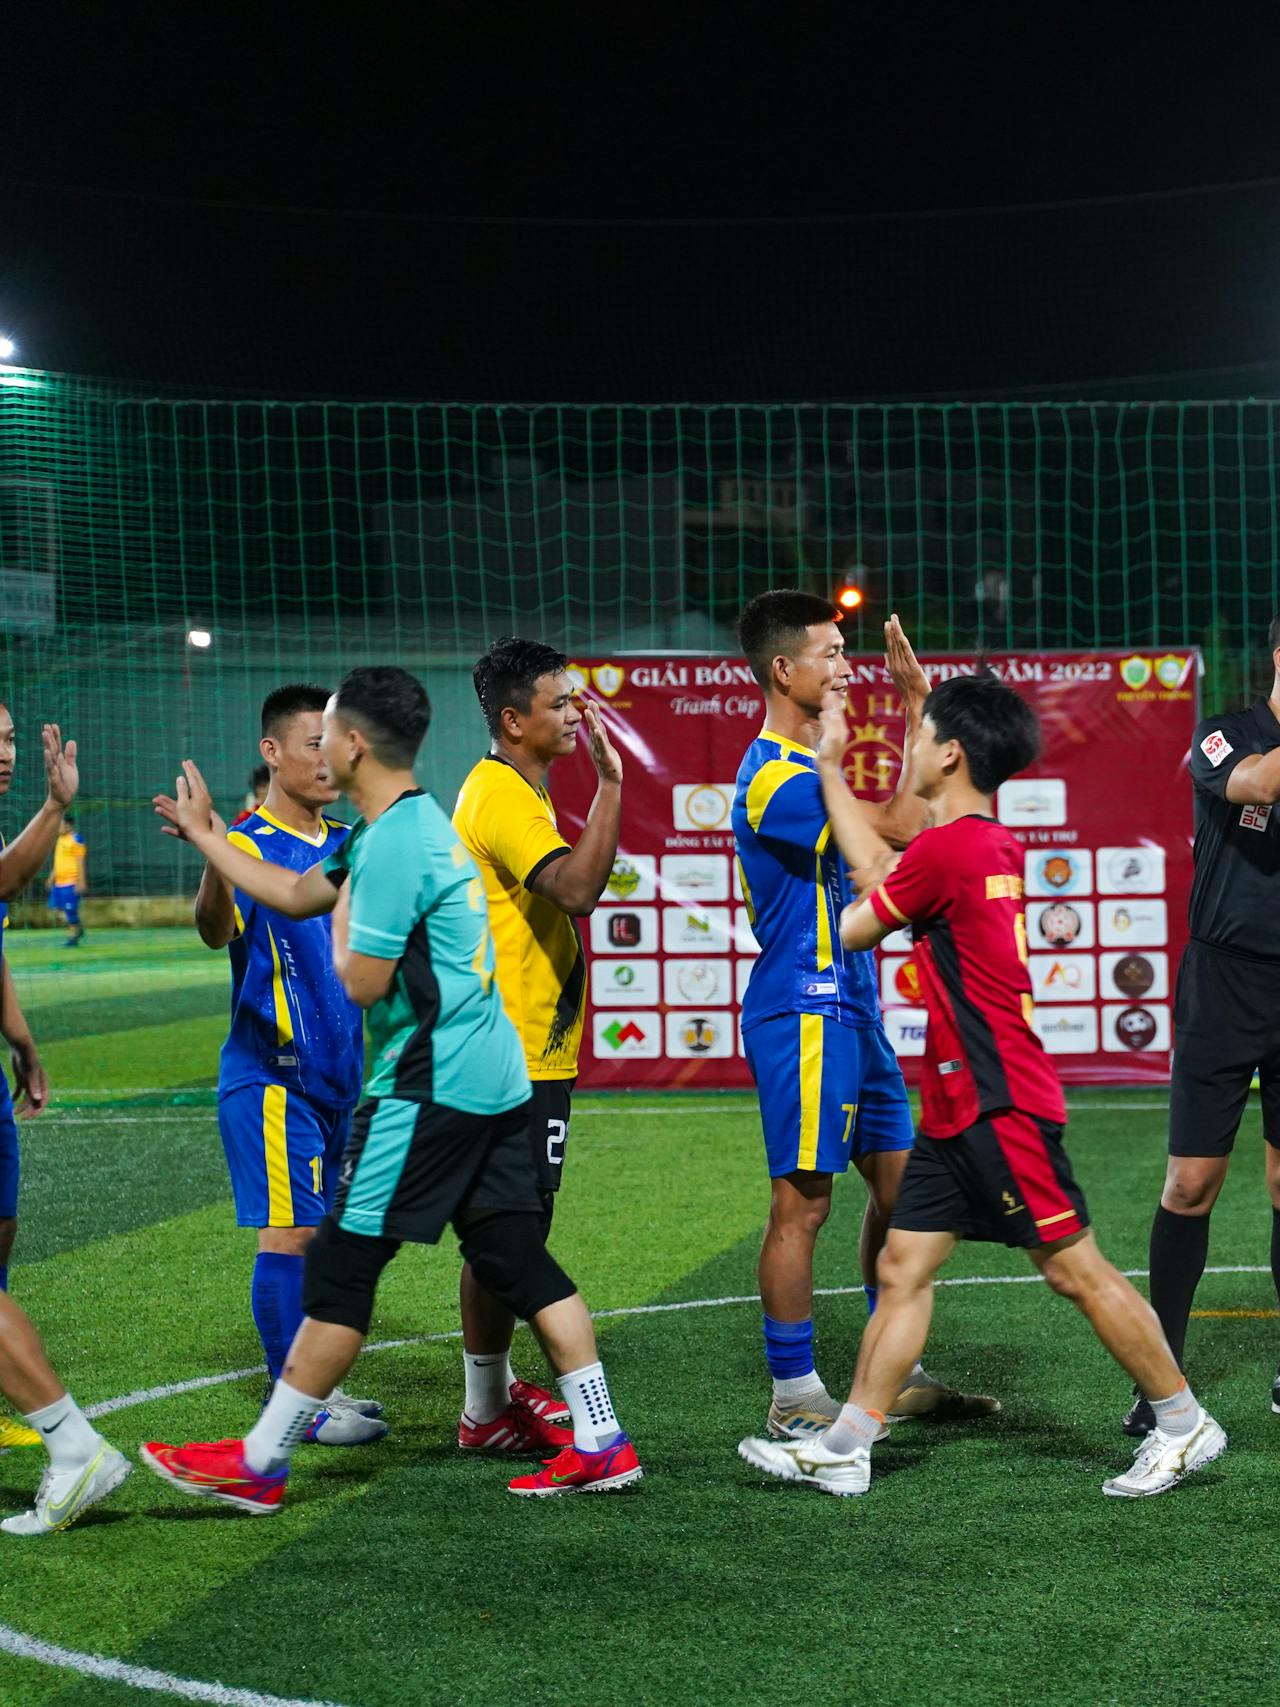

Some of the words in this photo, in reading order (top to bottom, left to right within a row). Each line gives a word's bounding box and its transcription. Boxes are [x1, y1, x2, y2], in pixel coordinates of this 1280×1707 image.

[630, 662, 688, 687] GIẢI
[695, 660, 759, 686] BÓN
[1049, 661, 1112, 681] 2022
[725, 694, 760, 719] Cúp
[546, 1118, 570, 1165] 2
[841, 1103, 858, 1143] 7
[308, 1155, 324, 1195] 1
